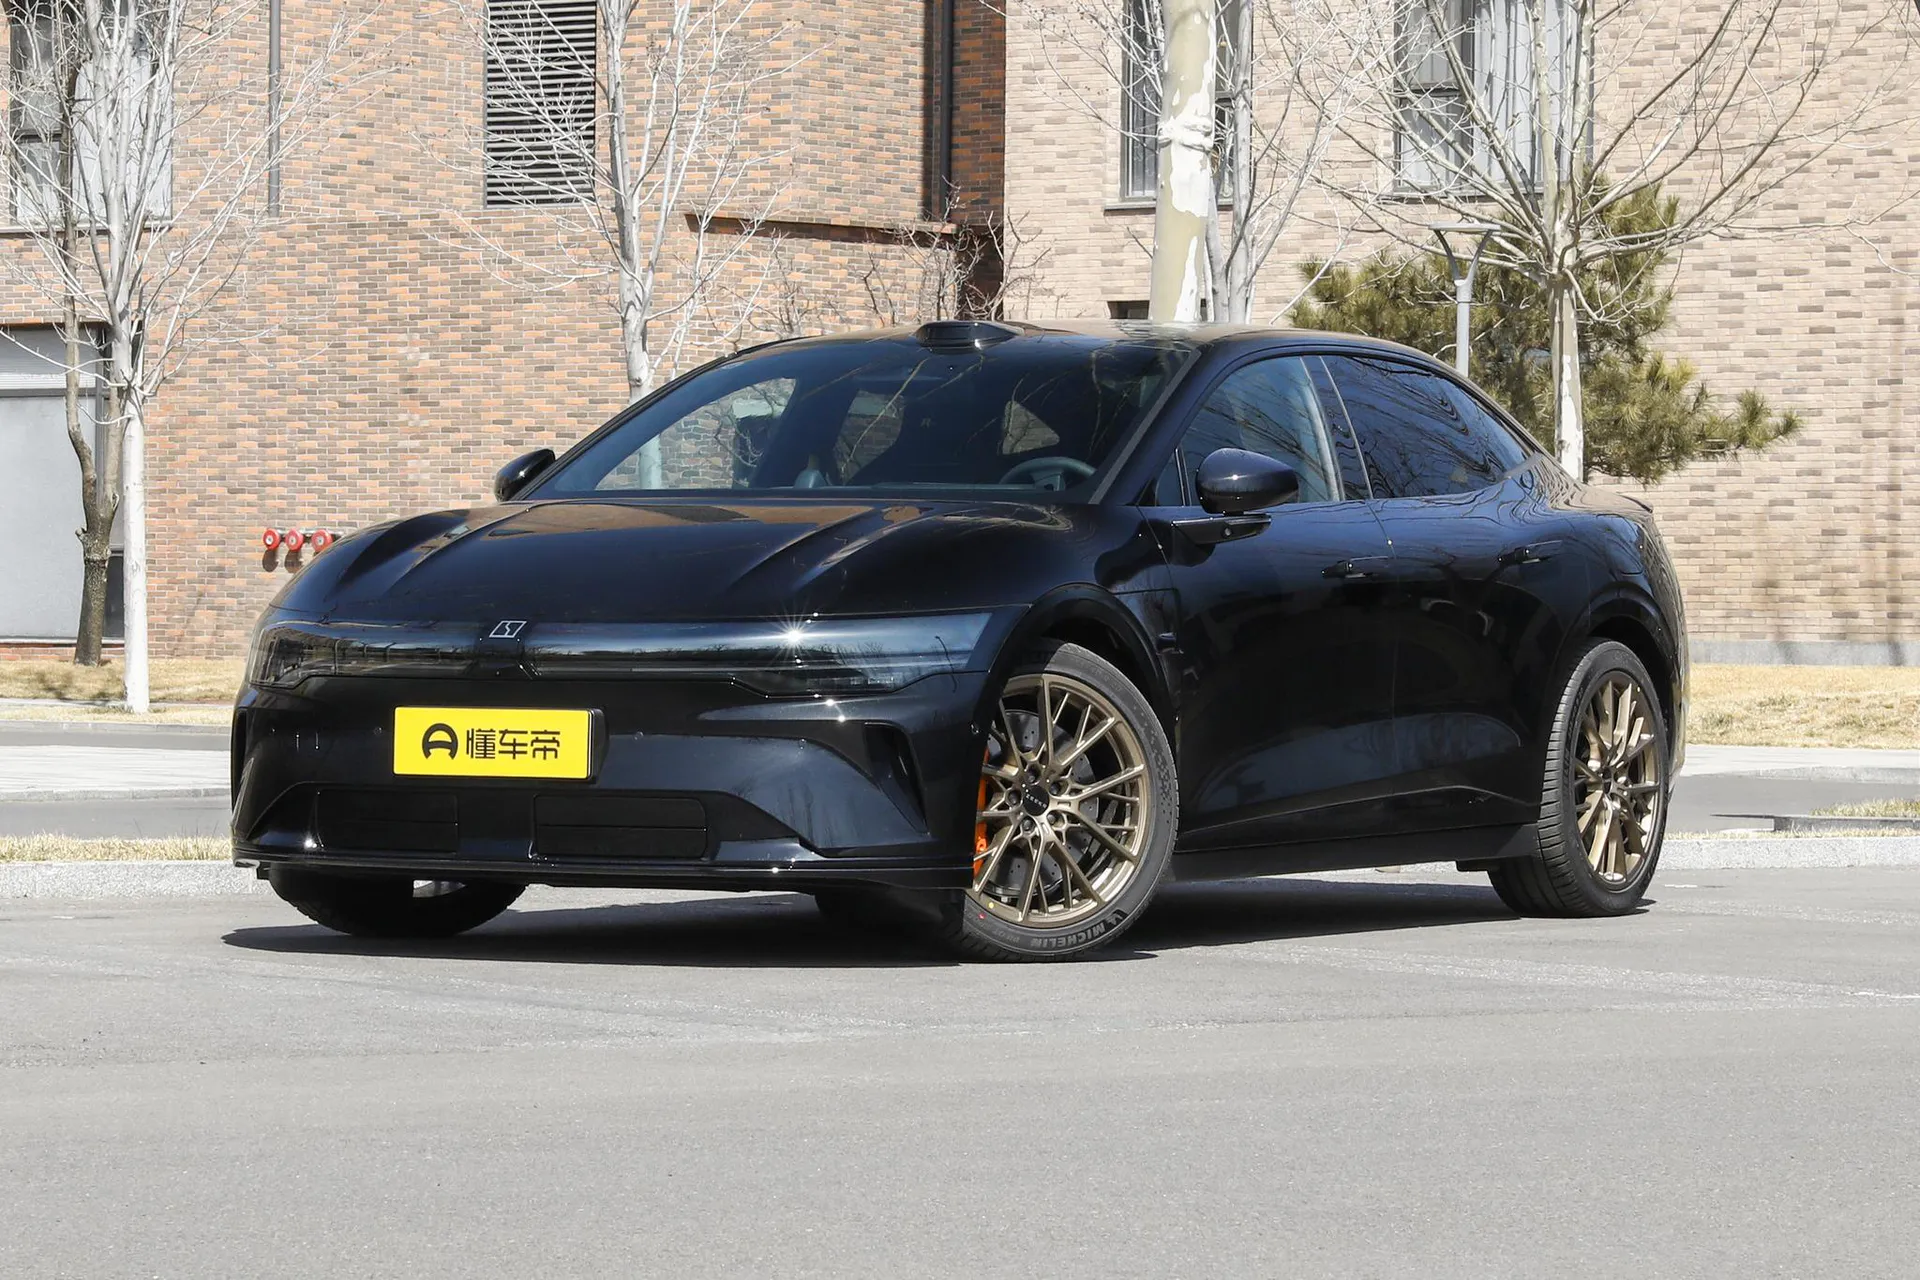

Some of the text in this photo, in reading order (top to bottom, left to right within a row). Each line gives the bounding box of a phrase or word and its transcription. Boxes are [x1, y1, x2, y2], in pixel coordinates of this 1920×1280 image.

[465, 727, 562, 761] 懂车帝
[1031, 923, 1106, 948] MICHELIN
